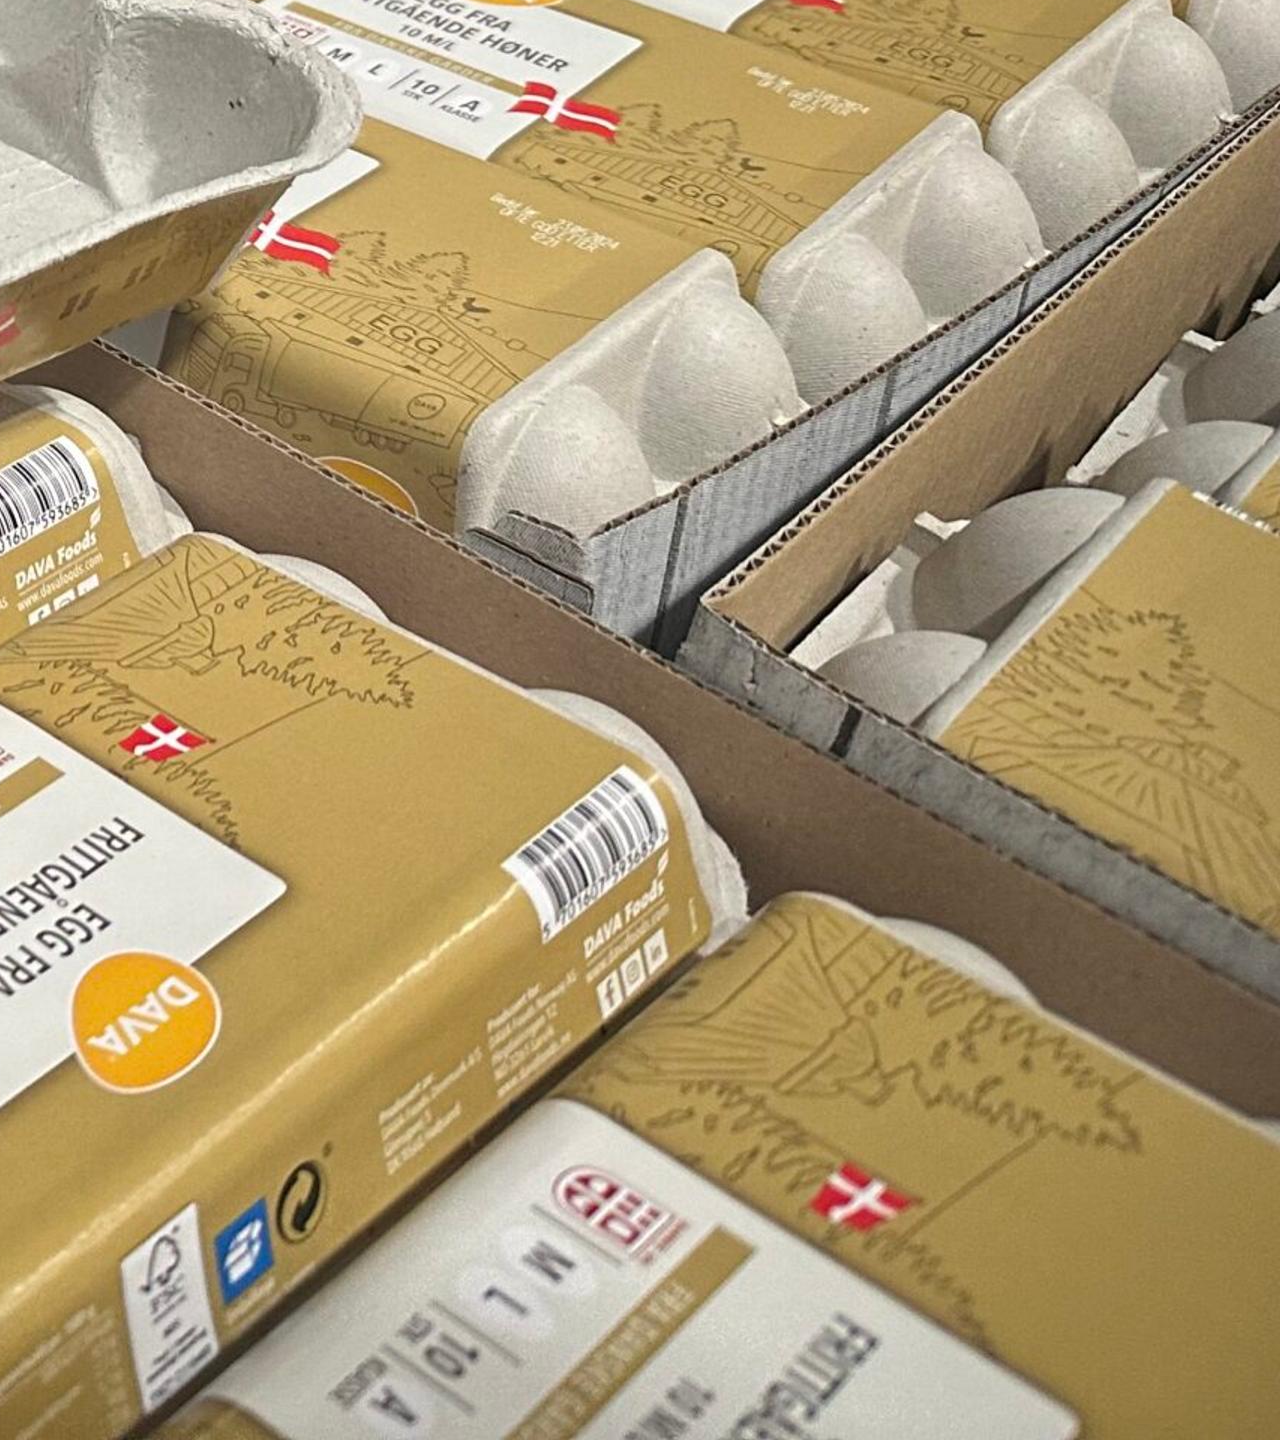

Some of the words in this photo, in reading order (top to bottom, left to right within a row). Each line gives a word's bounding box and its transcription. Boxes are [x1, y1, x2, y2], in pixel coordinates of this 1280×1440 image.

[399, 25, 422, 37] 10
[422, 34, 454, 51] M/L
[465, 10, 512, 32] FRA
[480, 34, 569, 72] HØNER
[892, 41, 955, 70] EGG
[327, 48, 353, 61] M
[368, 64, 383, 75] L
[412, 80, 440, 95] 10
[460, 100, 480, 112] A
[658, 174, 730, 211] EGG
[368, 313, 444, 357] EGG
[40, 492, 88, 529] 593685
[15, 554, 56, 590] DAVA
[56, 529, 99, 566] Foods
[17, 552, 104, 612] www.davafoods.com
[36, 904, 111, 957] EGG
[582, 917, 624, 959] DAVA
[624, 880, 668, 921] Foods
[87, 976, 200, 1055] DAVA
[525, 1246, 575, 1283] M
[483, 1287, 527, 1315] L
[424, 1336, 479, 1378] 10
[372, 1389, 416, 1424] A
